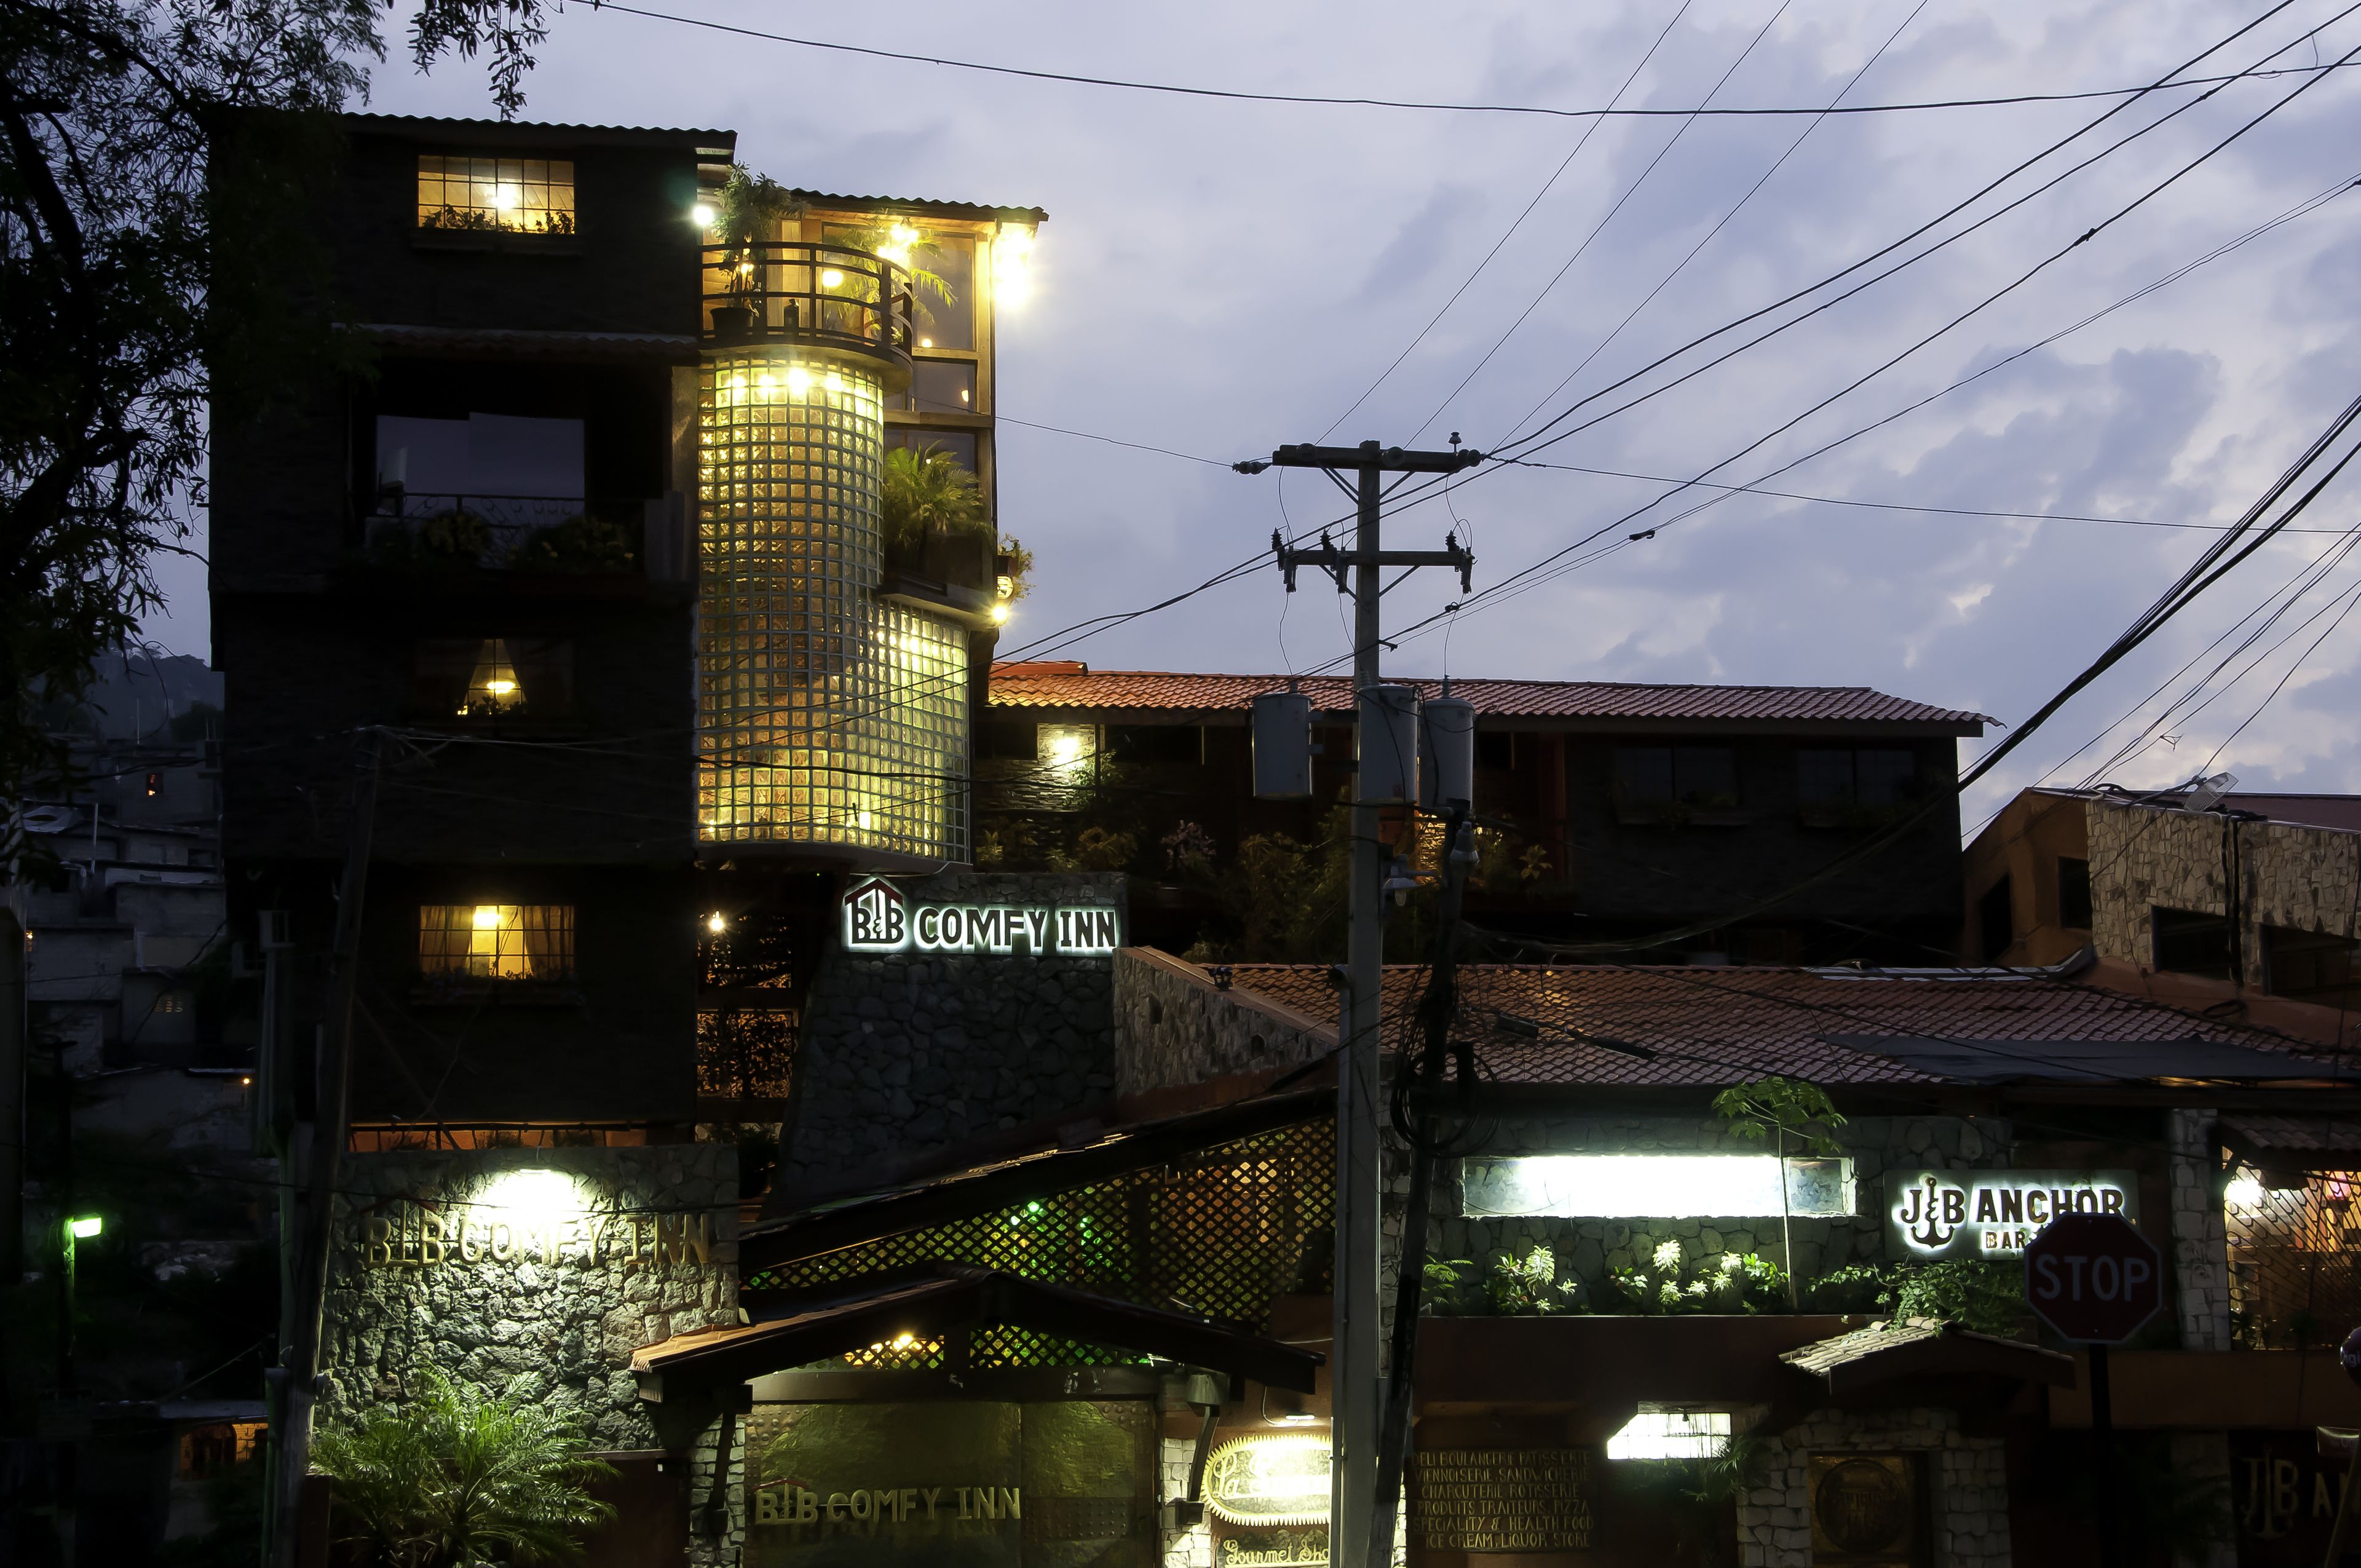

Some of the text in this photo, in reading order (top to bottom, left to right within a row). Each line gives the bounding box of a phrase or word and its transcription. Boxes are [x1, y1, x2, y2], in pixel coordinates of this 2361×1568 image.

[919, 906, 1046, 948] COMFY
[1059, 911, 1116, 948] INN
[1975, 1188, 2124, 1223] ANCHOR
[623, 1213, 710, 1264] INN
[1986, 1230, 2026, 1249] BAR
[2035, 1253, 2151, 1302] STOP
[1412, 1451, 1436, 1467] DELI
[826, 1487, 942, 1524] COMFY
[954, 1486, 1021, 1520] INN
[1509, 1515, 1560, 1531] HEALTH
[1564, 1515, 1594, 1531] FOOD
[1222, 1538, 1292, 1566] Gourmet
[1553, 1532, 1591, 1549] STORE
